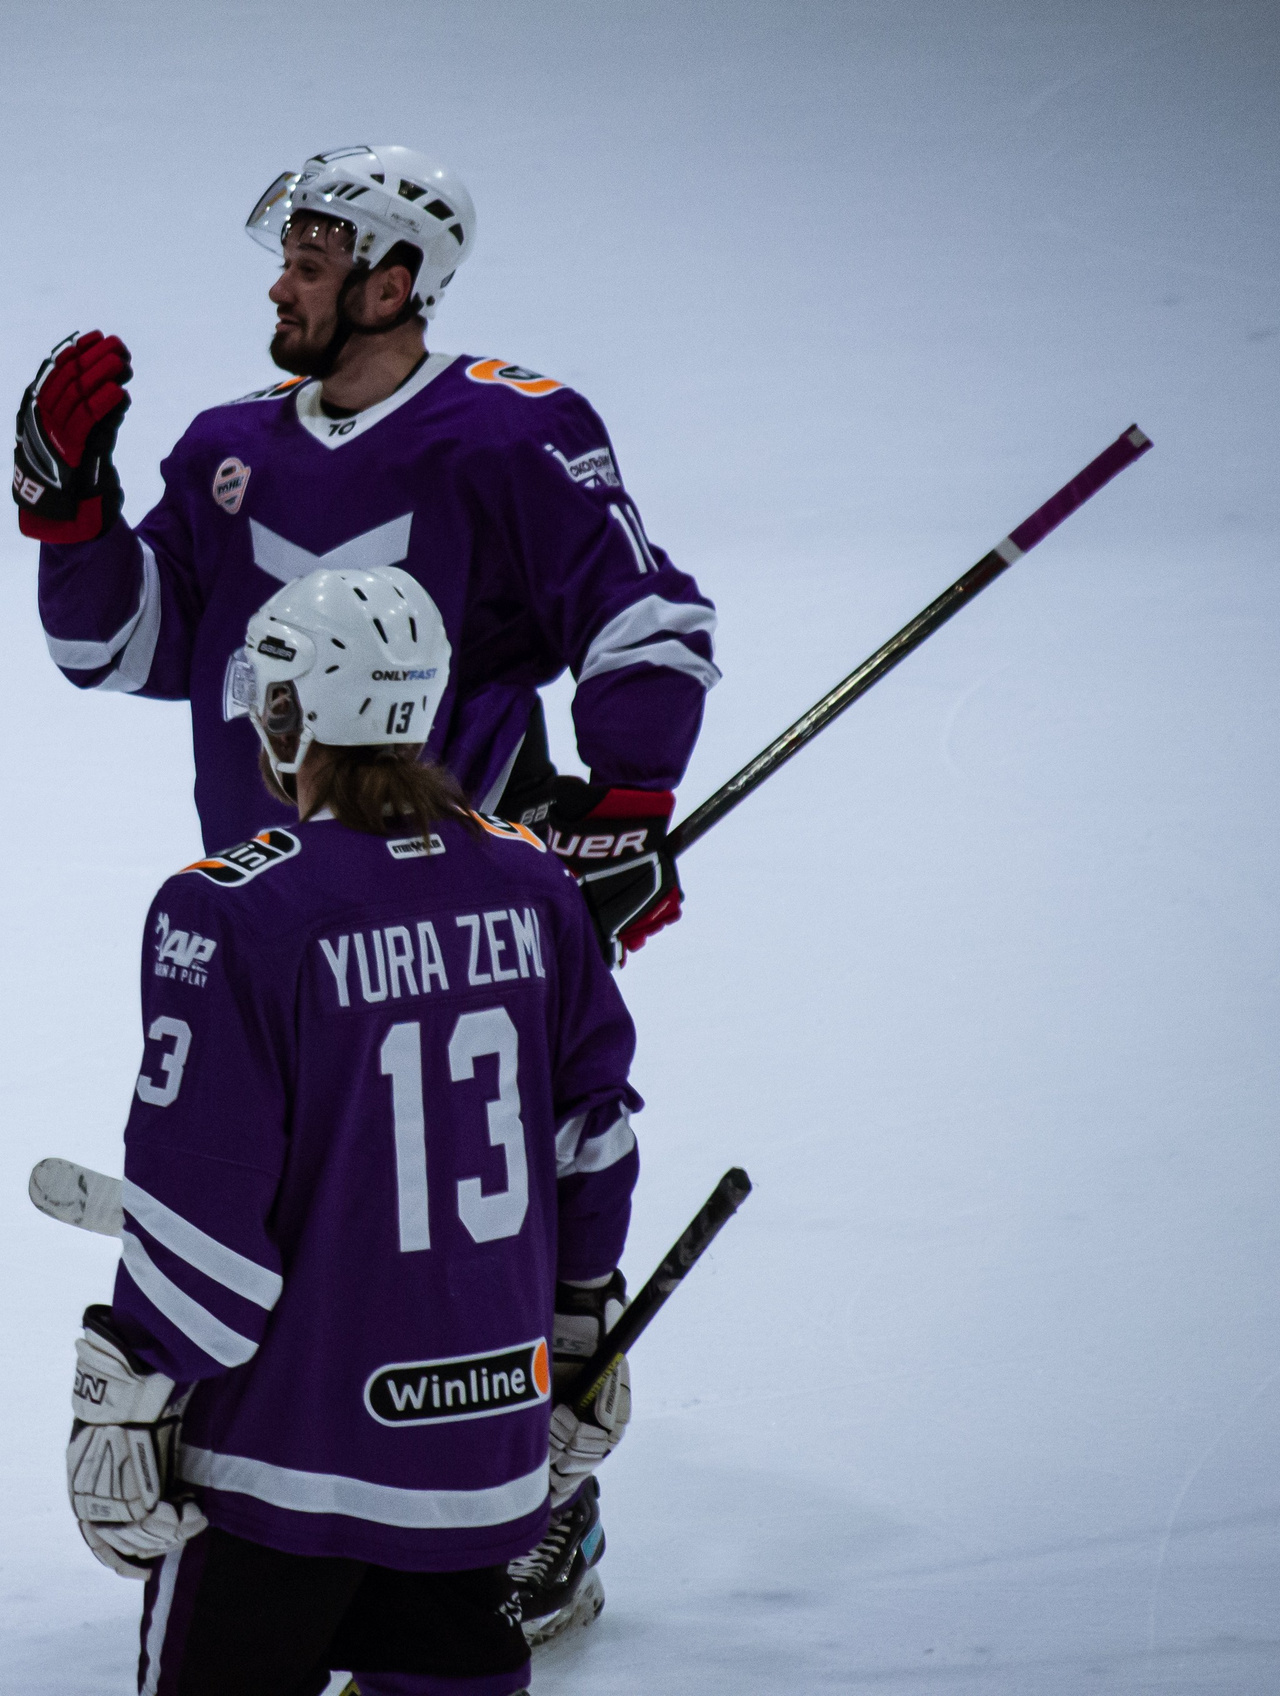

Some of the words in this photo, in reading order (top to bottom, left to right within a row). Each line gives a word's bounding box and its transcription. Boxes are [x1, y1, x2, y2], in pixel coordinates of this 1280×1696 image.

[328, 419, 357, 437] 10
[386, 702, 415, 735] 13
[548, 822, 649, 859] UER
[181, 968, 208, 989] PLAY
[318, 920, 450, 1008] YURA
[136, 1015, 193, 1108] 3
[380, 1006, 529, 1253] 13
[386, 1366, 527, 1412] Winline
